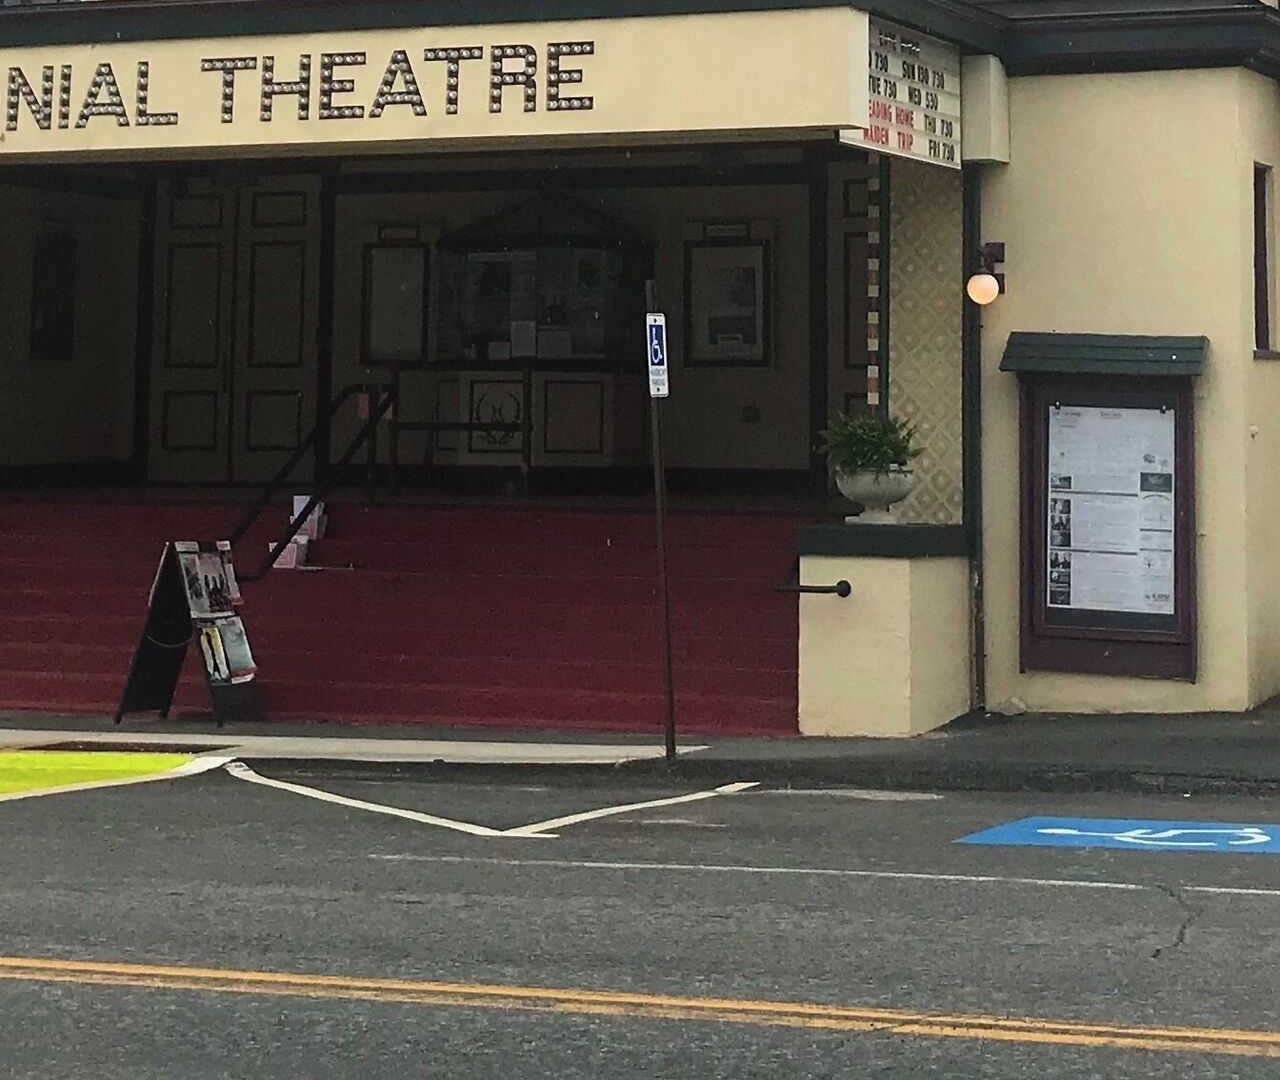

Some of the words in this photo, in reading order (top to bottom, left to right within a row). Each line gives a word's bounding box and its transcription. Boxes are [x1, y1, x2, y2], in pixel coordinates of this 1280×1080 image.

[201, 41, 595, 124] THEATRE
[875, 51, 889, 73] 730
[902, 61, 916, 80] SUN
[931, 70, 945, 90] 730
[883, 78, 897, 99] 730
[907, 85, 922, 106] WED
[895, 106, 915, 129] HOME
[923, 114, 937, 134] THU
[940, 118, 954, 138] 730
[863, 123, 889, 146] MAIDEN
[897, 131, 914, 151] TRIP
[928, 138, 941, 158] FRI
[941, 142, 955, 162] 730
